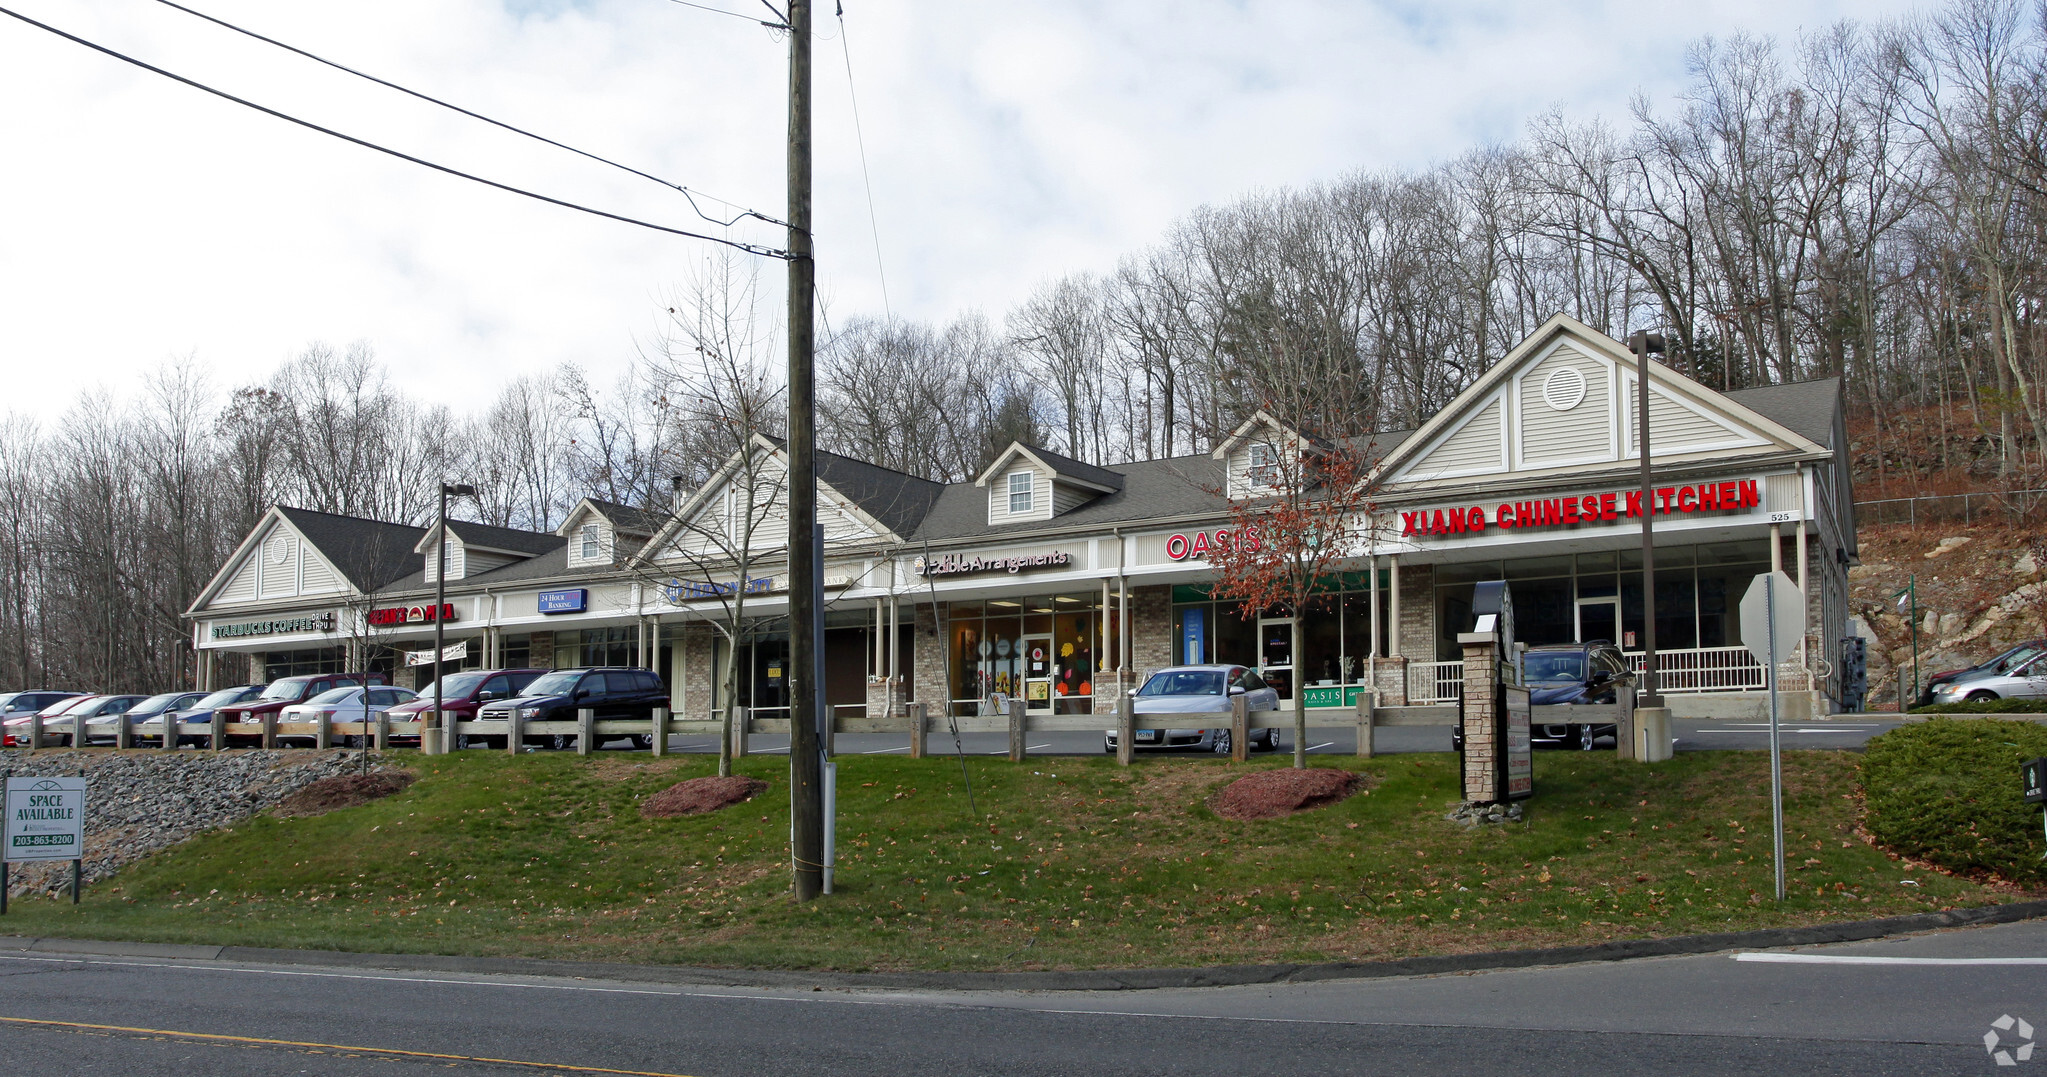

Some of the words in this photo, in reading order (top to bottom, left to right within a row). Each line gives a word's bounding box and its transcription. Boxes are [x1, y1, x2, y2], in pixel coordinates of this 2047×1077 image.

[1401, 507, 1485, 537] XIANG
[1497, 493, 1618, 529] CHINESE
[1626, 480, 1758, 518] KITCHEN
[1771, 513, 1790, 522] 525
[929, 554, 970, 574] Edible
[970, 551, 1068, 574] Arrangements
[824, 576, 845, 585] ANK
[549, 594, 565, 602] HOUR
[311, 612, 329, 621] DRIVE
[212, 621, 271, 637] STARBUCKS
[272, 618, 312, 633] COFFEE
[311, 621, 328, 630] THRU
[29, 795, 63, 806] SPACE
[16, 808, 73, 820] AVAILABLE
[15, 835, 72, 845] 203-863-8200
